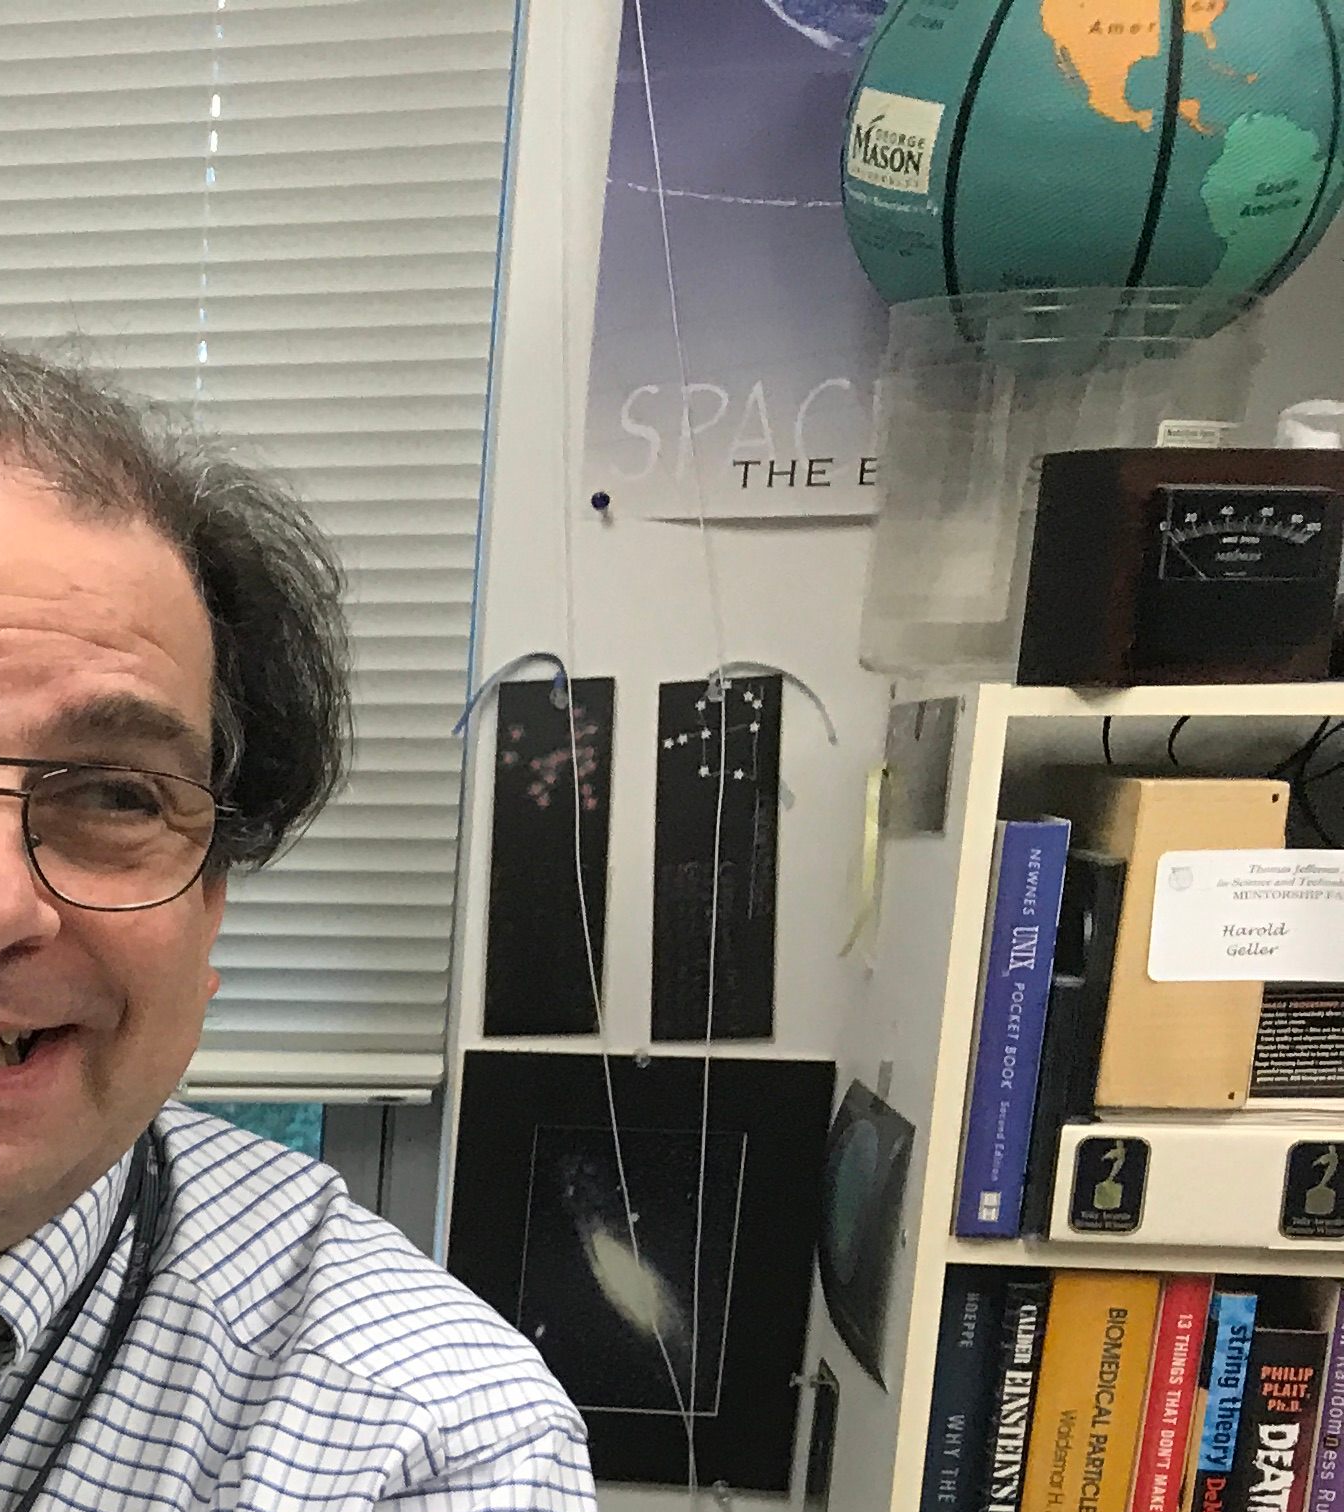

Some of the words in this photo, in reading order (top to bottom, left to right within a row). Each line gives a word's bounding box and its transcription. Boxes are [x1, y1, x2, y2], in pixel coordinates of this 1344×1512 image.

[852, 122, 924, 177] MASON
[875, 127, 927, 151] GEORGE
[732, 456, 833, 489] THE
[1022, 847, 1042, 917] NEWNES
[1232, 890, 1324, 901] MENTORSHIP
[1009, 925, 1040, 973] UNIX
[1222, 922, 1290, 938] Harold
[1226, 944, 1280, 958] Geller
[1005, 981, 1026, 1040] POCKET
[1000, 1044, 1018, 1089] BOOK
[958, 1291, 981, 1349] HOEPPE
[1013, 1303, 1039, 1365] CALDER
[1176, 1313, 1194, 1330] 13
[1090, 1306, 1129, 1429] BIOMEDICAL
[1169, 1333, 1191, 1386] THINGS
[1217, 1324, 1252, 1391] string
[1260, 1364, 1314, 1383] PHILIP
[1161, 1389, 1183, 1427] THAT
[1266, 1399, 1303, 1413] Ph.D.
[943, 1413, 966, 1459] WHY
[990, 1369, 1034, 1500] EINSTEIN'S
[1156, 1428, 1176, 1470] DON'T
[1205, 1396, 1243, 1468] theory
[936, 1466, 960, 1504] THE
[1149, 1474, 1169, 1512] MAKE
